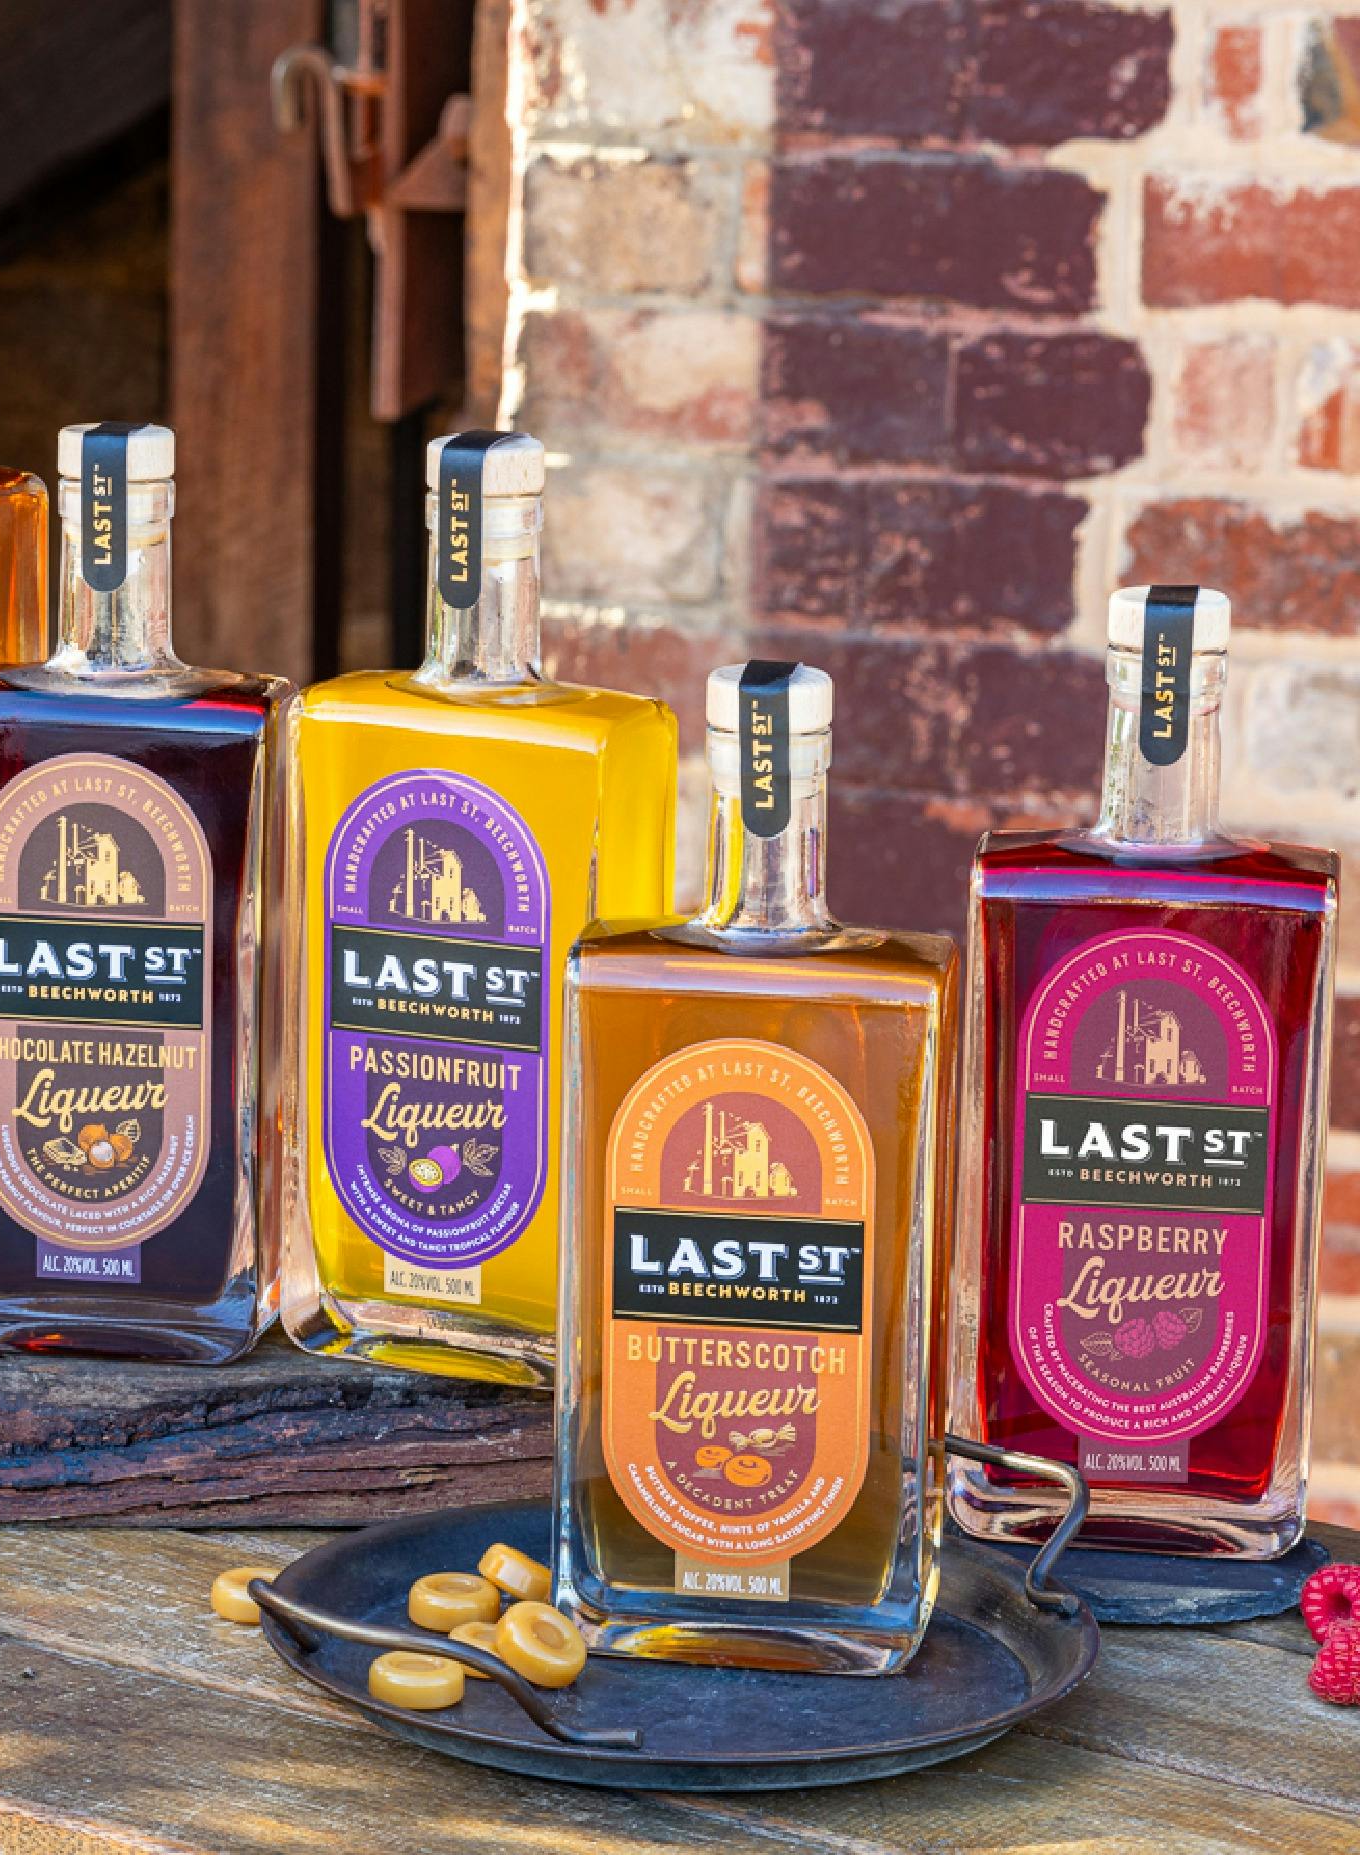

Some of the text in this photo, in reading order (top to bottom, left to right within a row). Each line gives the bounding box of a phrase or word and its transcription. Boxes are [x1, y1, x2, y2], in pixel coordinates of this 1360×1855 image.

[93, 501, 112, 565] LAST
[450, 517, 469, 582] LAST
[1153, 671, 1176, 739] LAST
[50, 780, 69, 798] AT
[74, 777, 113, 793] LAST
[752, 739, 775, 810] LAST
[399, 792, 416, 810] AT
[420, 792, 456, 807] LAST
[343, 948, 477, 1002] LAST
[1112, 952, 1129, 971] AT
[1137, 950, 1177, 968] LAST
[27, 984, 154, 1004] BEECHWORTH
[377, 998, 494, 1025] BEECHWORTH
[98, 1041, 198, 1070] HAZELNUT
[350, 1045, 522, 1091] PASSIONFRUIT
[697, 1063, 715, 1082] AT
[722, 1061, 764, 1080] LAST
[11, 1068, 169, 1133] Liqueur
[360, 1082, 508, 1148] Liqueur
[1040, 1118, 1195, 1166] LAST
[26, 1147, 45, 1174] THE
[44, 1172, 100, 1199] PERFECT
[1079, 1168, 1214, 1188] BEECHWORTH
[384, 1178, 424, 1212] SWEET
[441, 1189, 480, 1216] TANGY
[1058, 1221, 1228, 1255] RASPBERRY
[102, 1257, 120, 1276] 500
[629, 1234, 789, 1282] LAST
[445, 1276, 462, 1295] 500
[667, 1282, 807, 1303] BEECHWORTH
[1056, 1255, 1226, 1324] Liqueur
[626, 1334, 846, 1375] BUTTERSCOTCH
[1078, 1352, 1196, 1392] SEASONAL FRUIT
[647, 1370, 822, 1439] Liqueur
[1112, 1401, 1130, 1413] THE
[1133, 1403, 1157, 1414] BEST
[1148, 1454, 1168, 1472] 500
[676, 1472, 753, 1511] DECADENT
[759, 1469, 800, 1505] TREAT
[748, 1574, 768, 1594] 500
